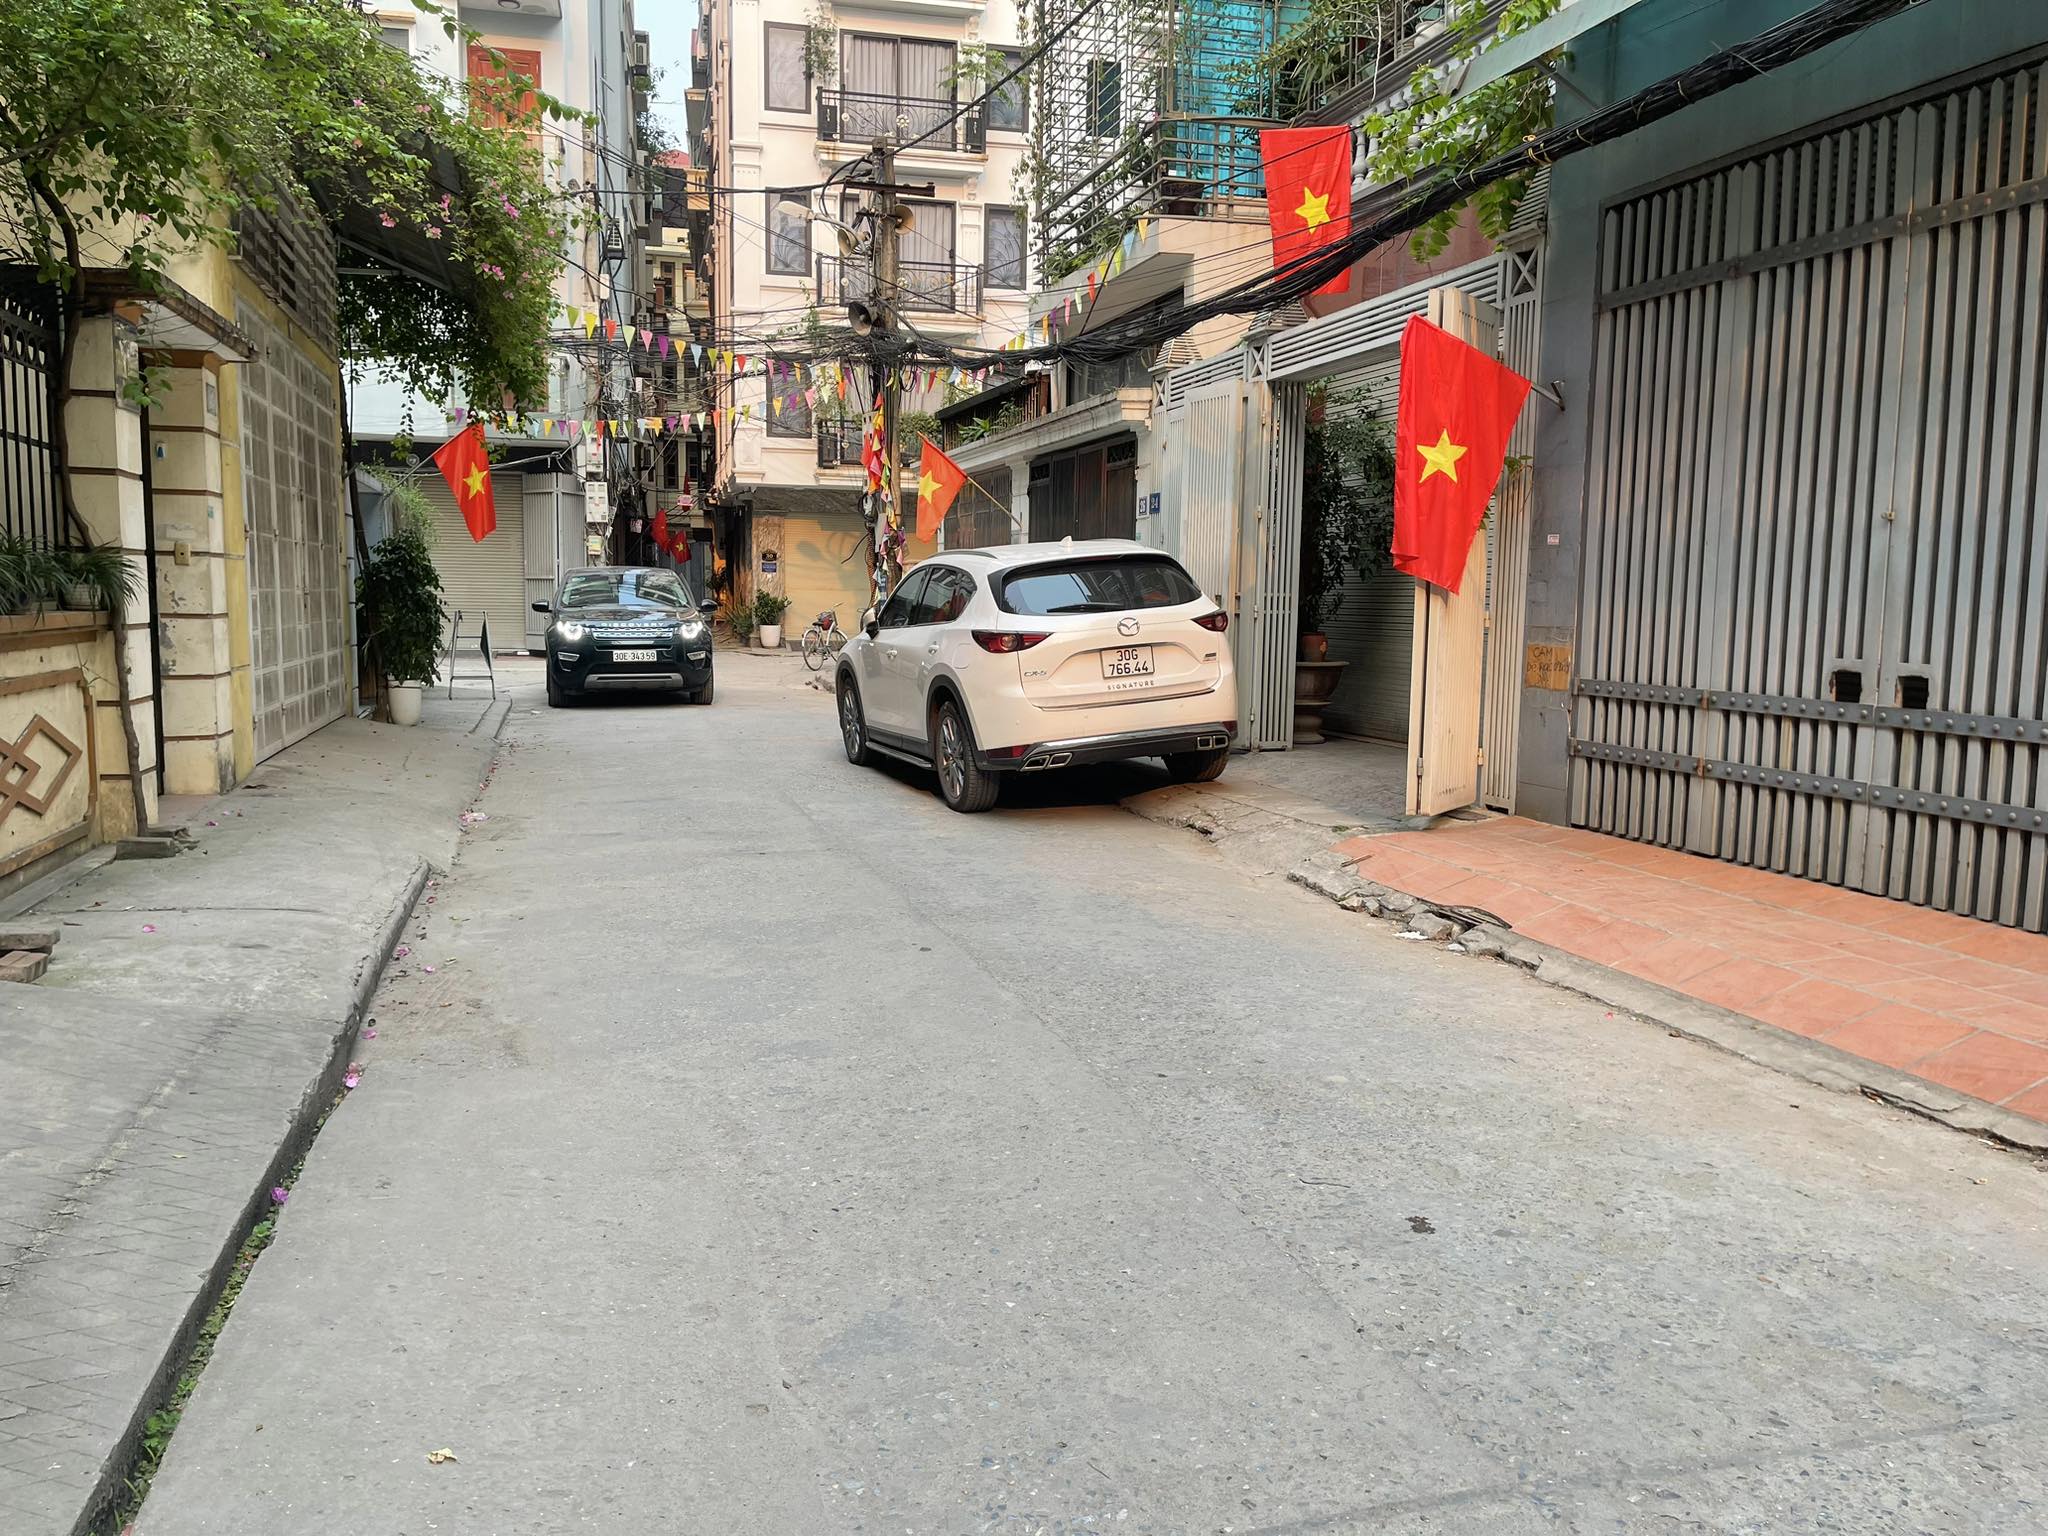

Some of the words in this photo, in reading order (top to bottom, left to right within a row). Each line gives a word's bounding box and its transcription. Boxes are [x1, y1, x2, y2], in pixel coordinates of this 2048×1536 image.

[1116, 648, 1138, 662] 30G
[1108, 660, 1149, 676] 766.44
[1107, 680, 1155, 691] SIGNATURE
